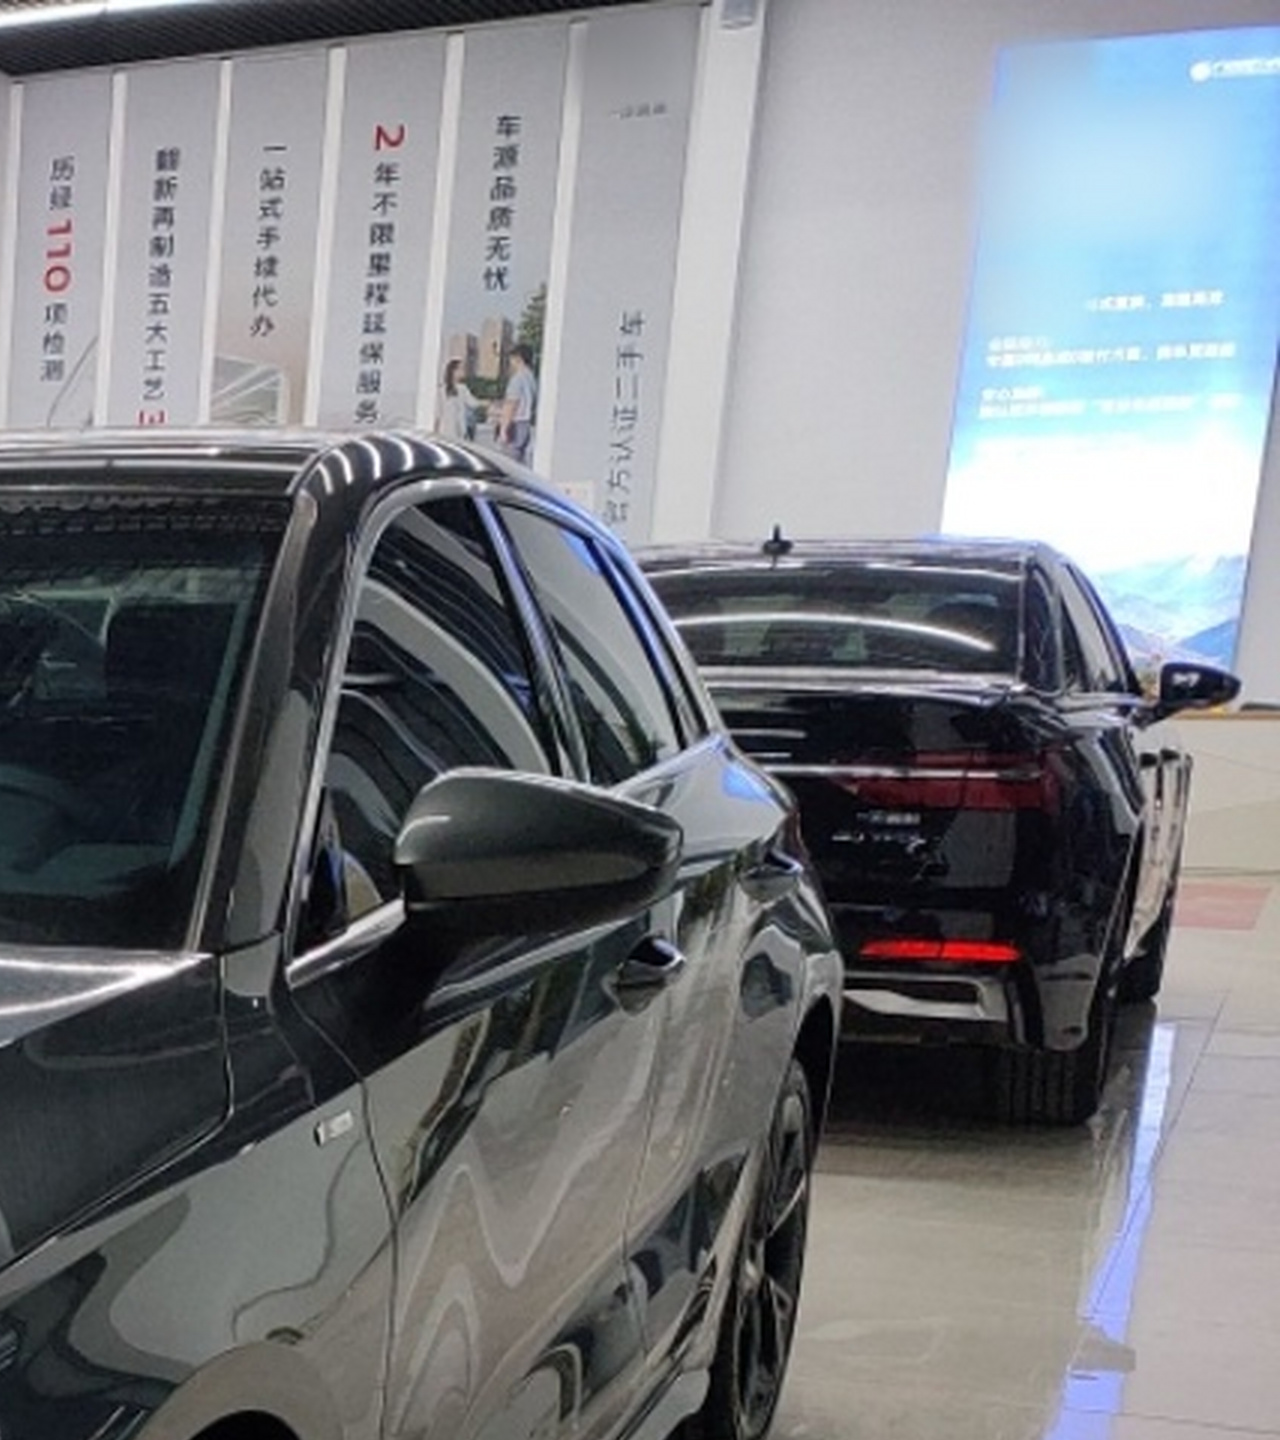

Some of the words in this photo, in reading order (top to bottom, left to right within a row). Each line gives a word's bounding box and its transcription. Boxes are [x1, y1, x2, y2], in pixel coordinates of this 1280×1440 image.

[251, 145, 287, 337] 一站式手续代办
[483, 114, 521, 291] 车源品质无忧
